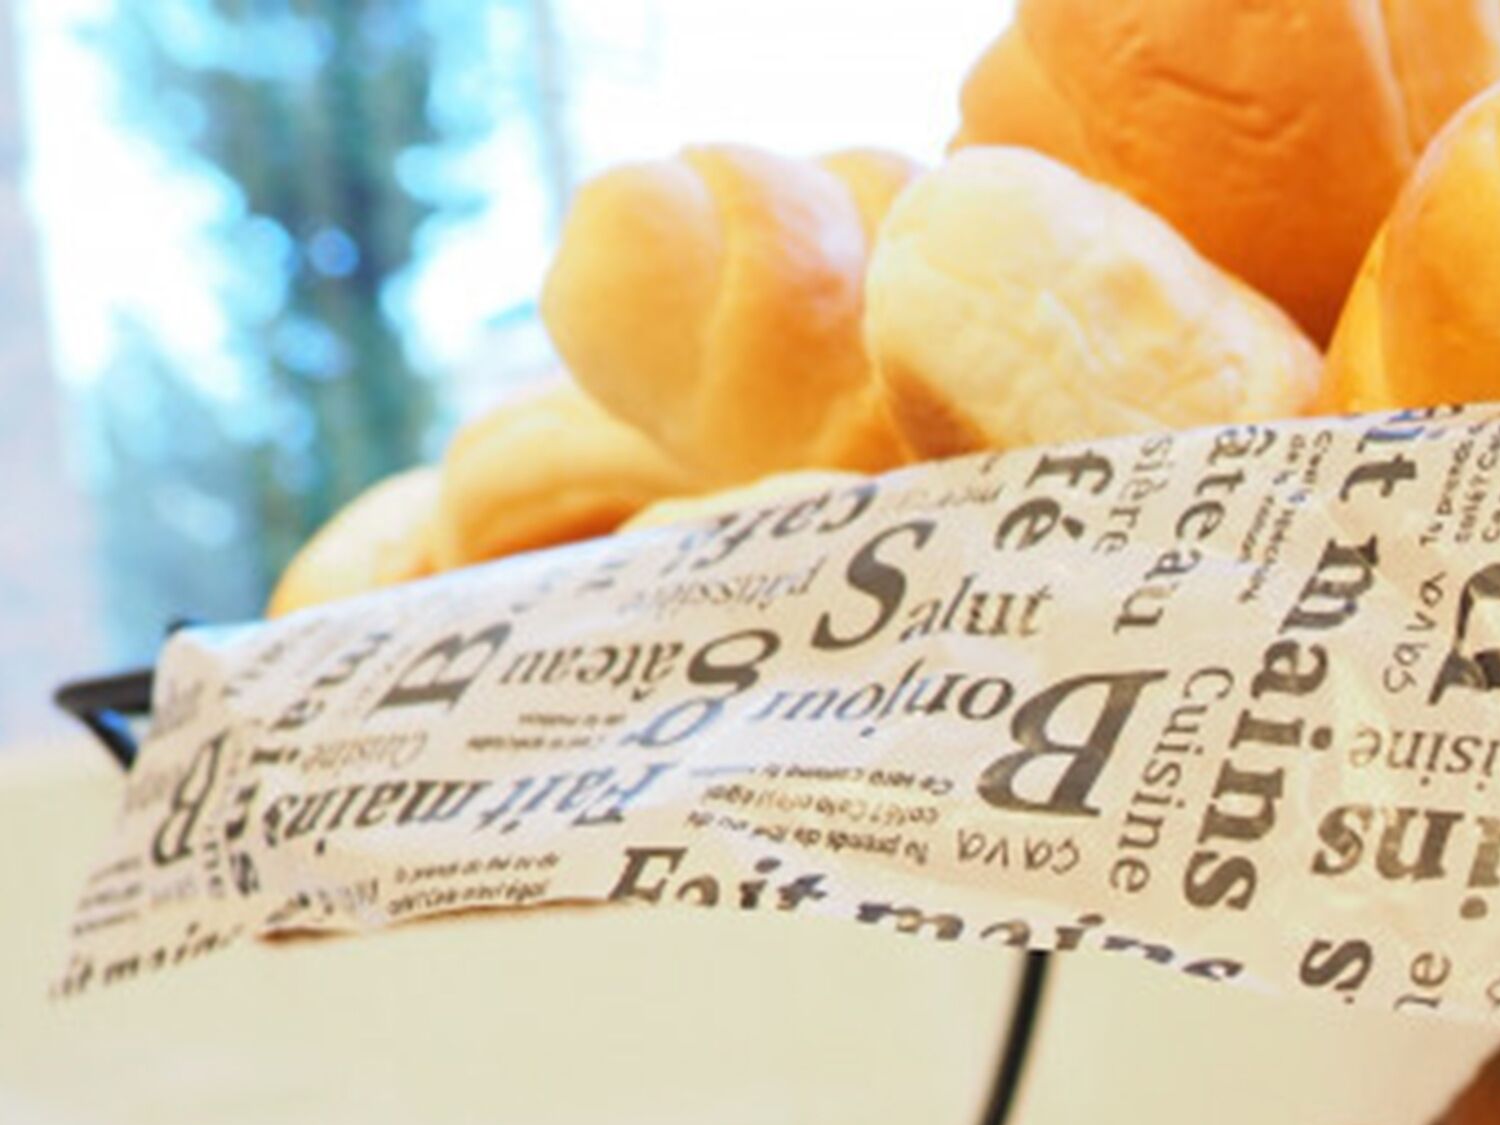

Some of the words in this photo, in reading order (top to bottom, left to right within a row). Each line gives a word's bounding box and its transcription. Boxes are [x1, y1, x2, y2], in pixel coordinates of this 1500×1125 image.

[810, 518, 1053, 652] Salut
[749, 658, 1170, 818] Bonjour
[1107, 667, 1236, 894] Cuisine
[1180, 533, 1381, 911] mains
